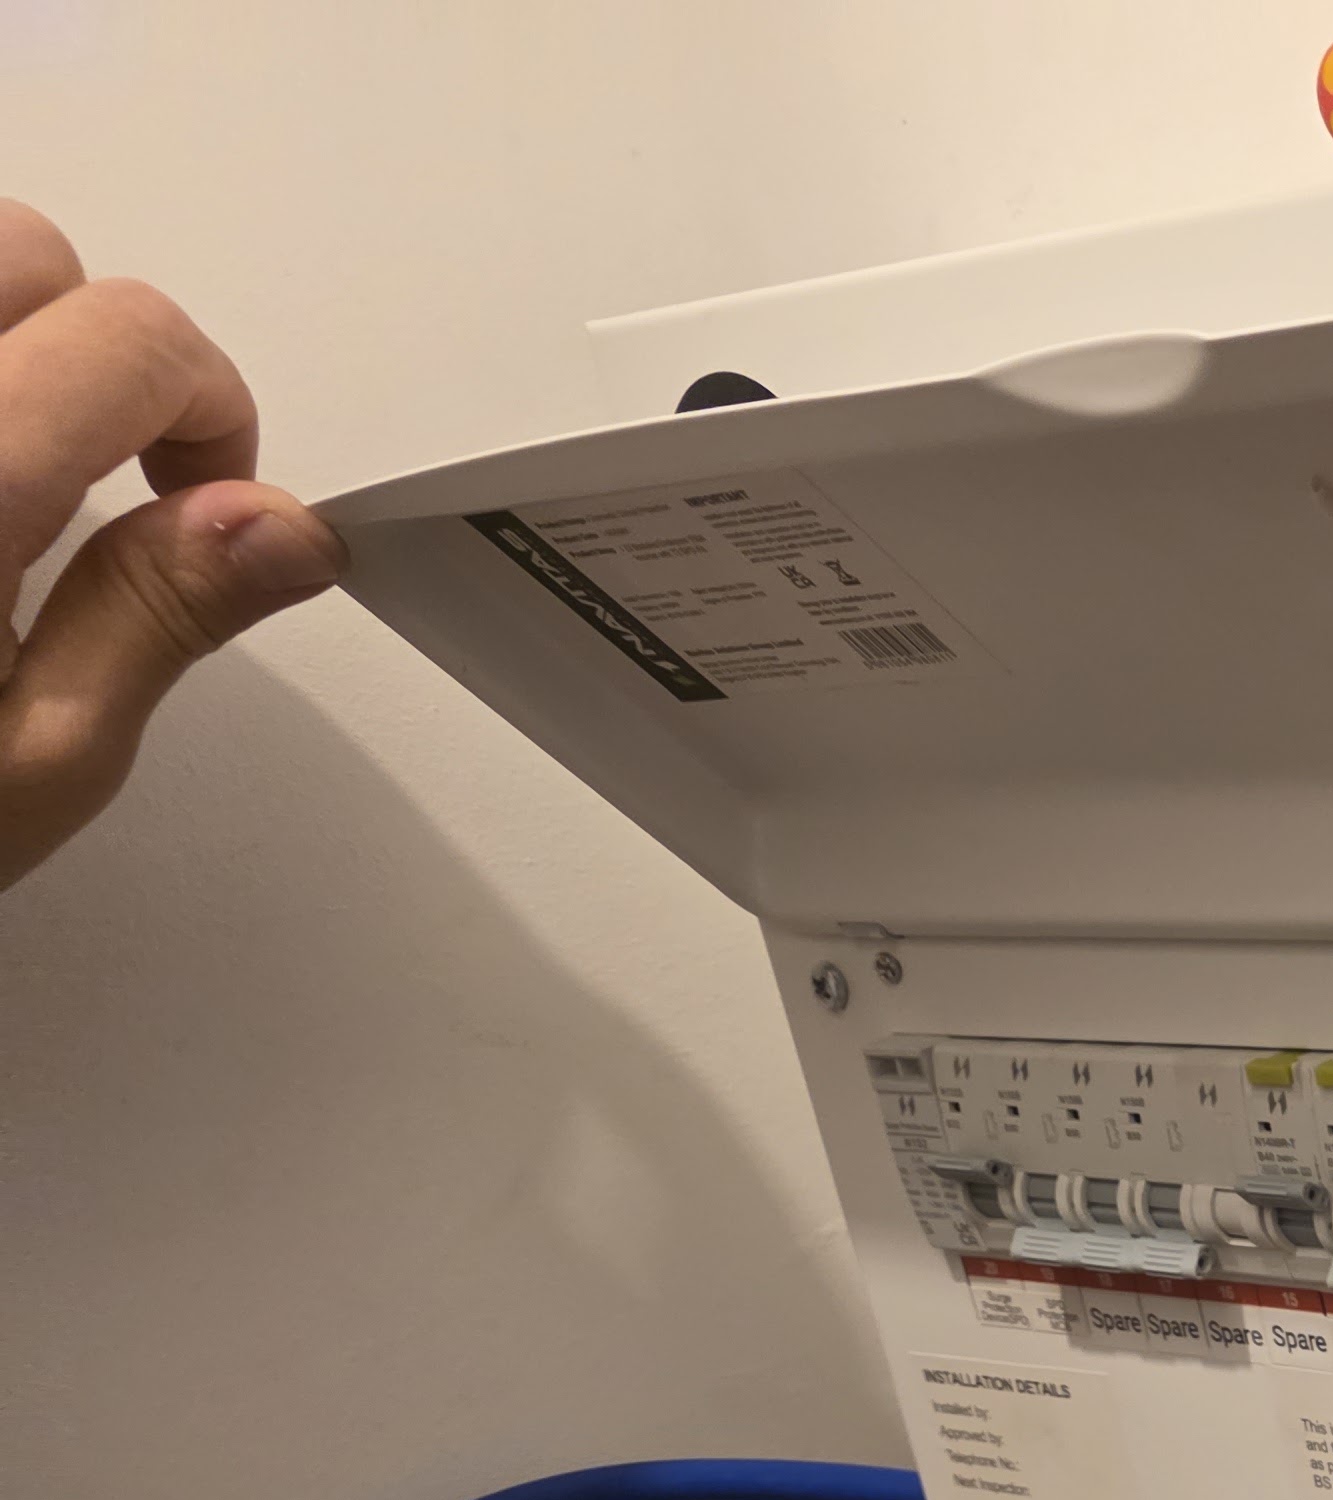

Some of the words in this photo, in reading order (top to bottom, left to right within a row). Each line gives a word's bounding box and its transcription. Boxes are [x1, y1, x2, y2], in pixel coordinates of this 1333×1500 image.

[497, 528, 656, 655] NAVITAS
[1282, 1291, 1299, 1307] 15
[1091, 1308, 1141, 1334] Spare
[1148, 1313, 1199, 1339] Spare
[1209, 1321, 1263, 1347] Spare
[1272, 1326, 1327, 1352] Spare
[922, 1369, 1015, 1392] INSTALLATION
[1016, 1379, 1071, 1399] DETAILS
[1310, 1459, 1324, 1470] as
